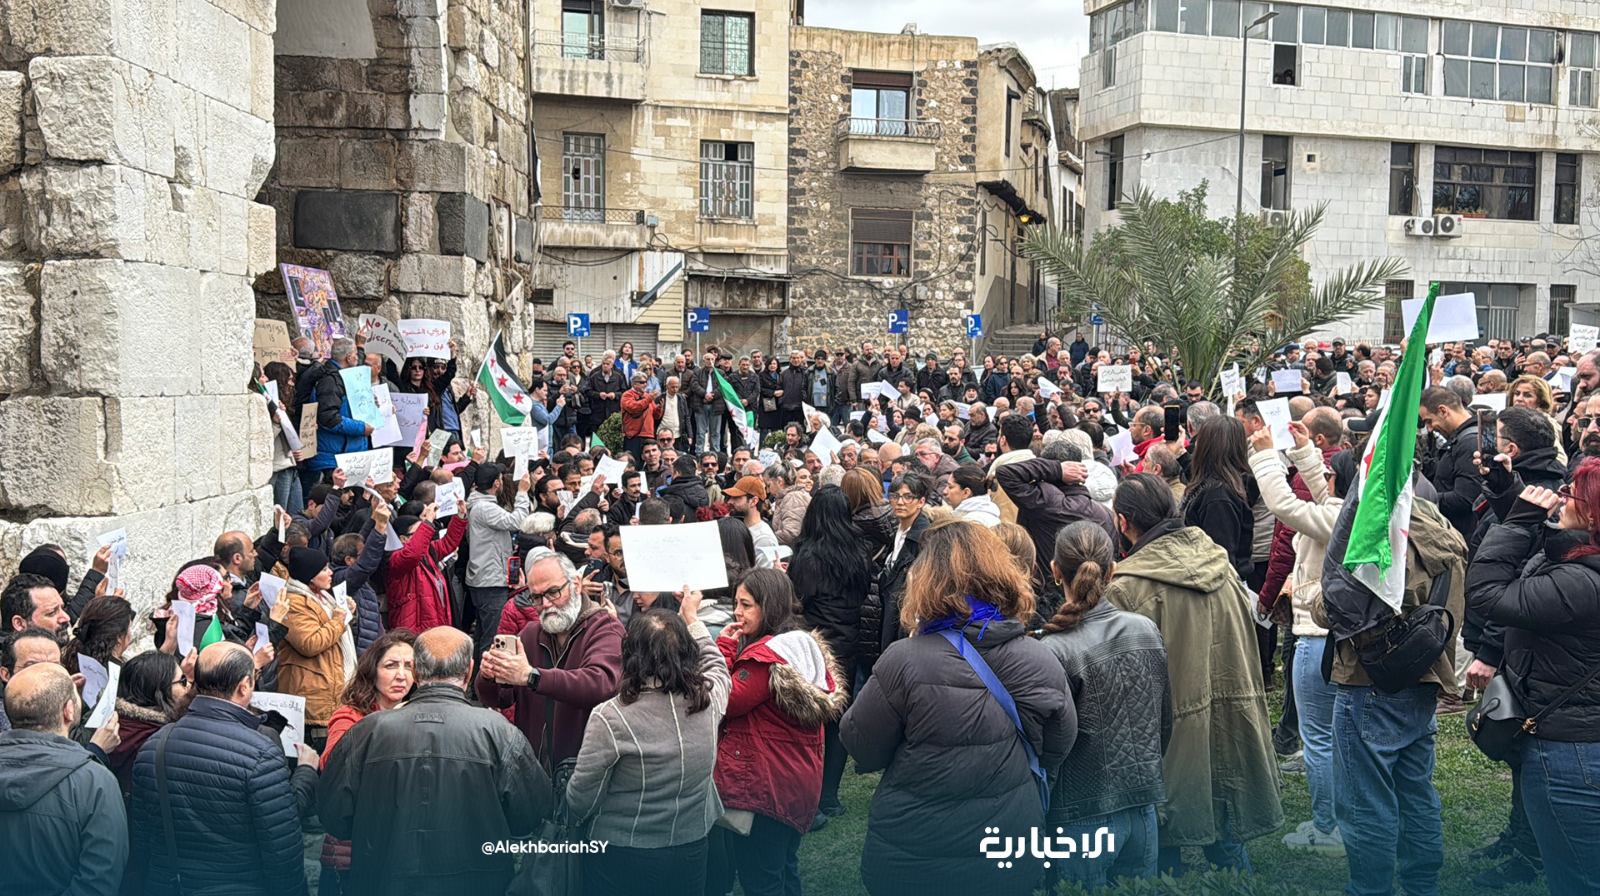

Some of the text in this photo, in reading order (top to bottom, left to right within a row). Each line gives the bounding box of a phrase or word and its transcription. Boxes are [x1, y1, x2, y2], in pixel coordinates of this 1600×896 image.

[365, 318, 381, 331] No
[570, 316, 581, 333] P
[688, 312, 697, 328] P
[889, 313, 898, 329] P
[968, 316, 975, 333] P
